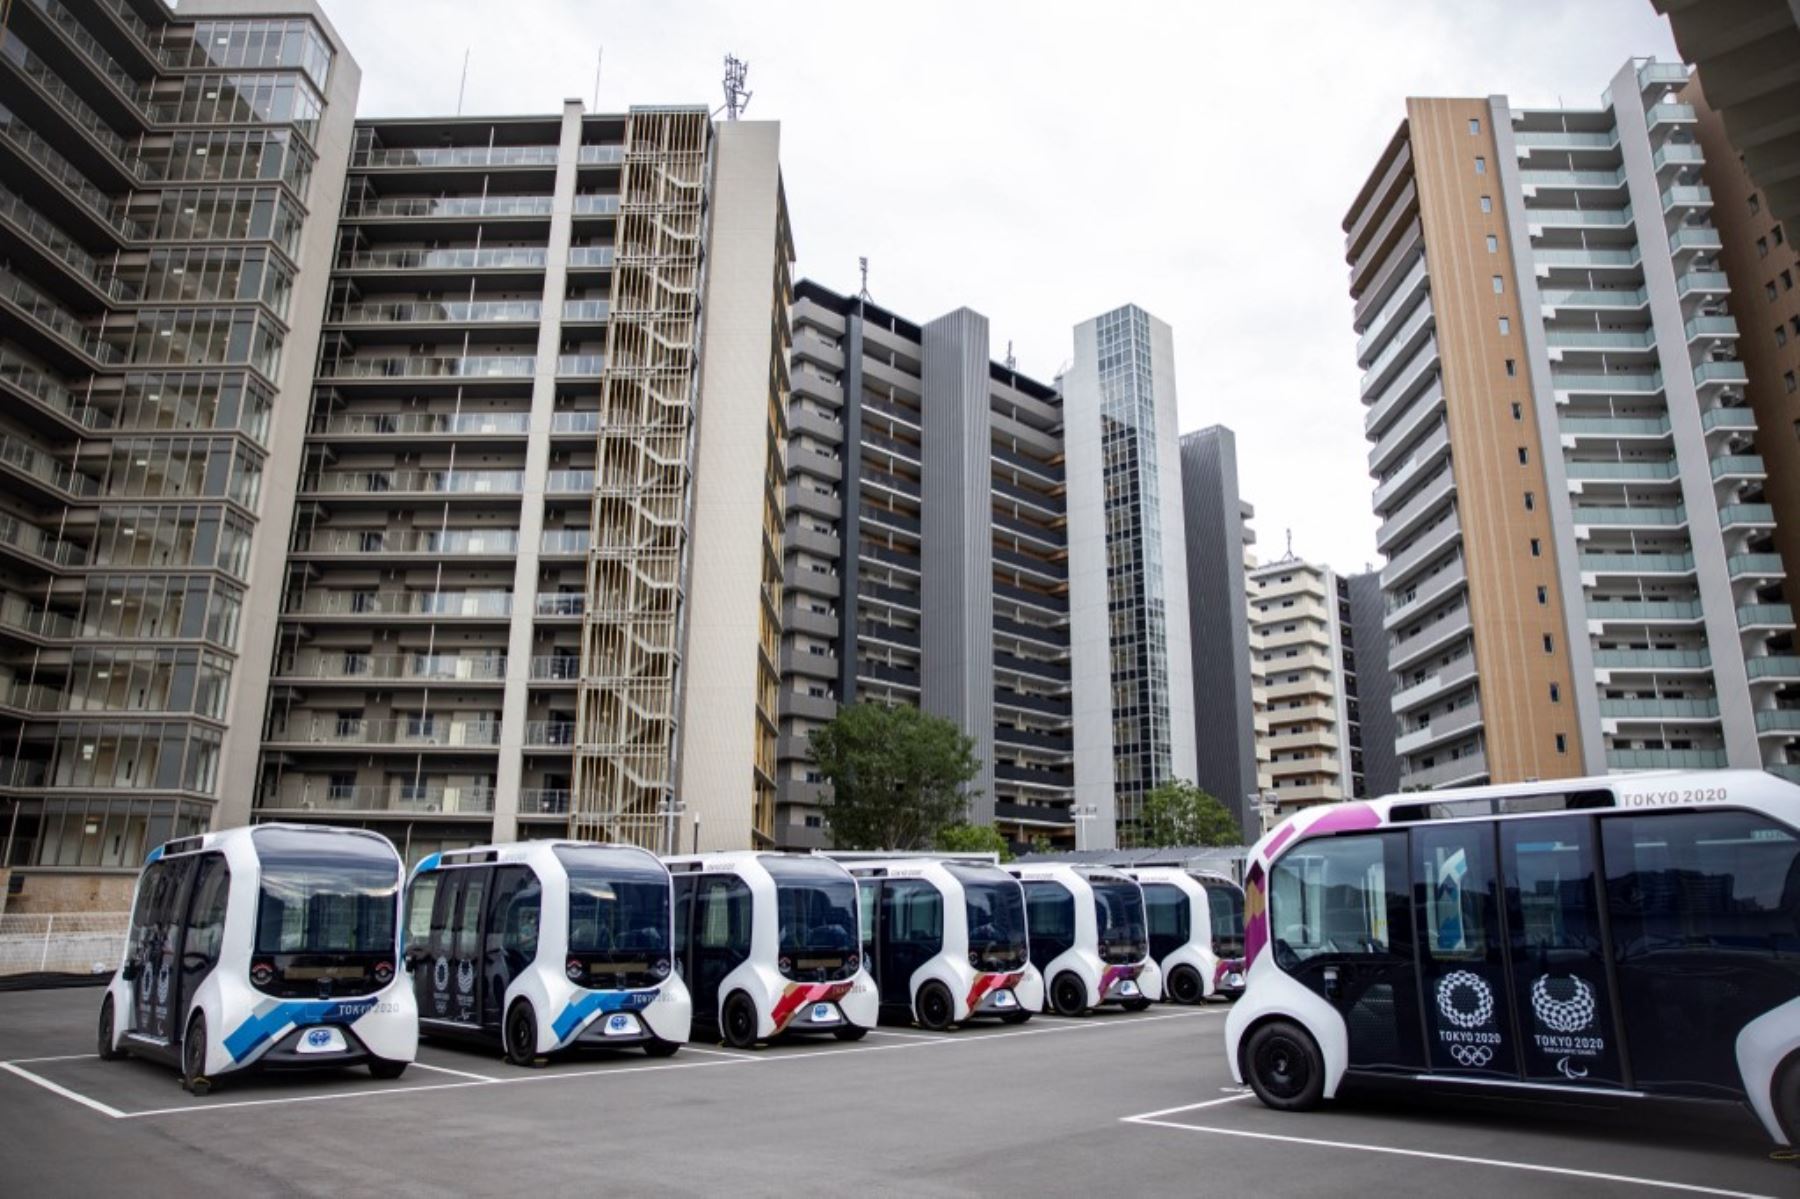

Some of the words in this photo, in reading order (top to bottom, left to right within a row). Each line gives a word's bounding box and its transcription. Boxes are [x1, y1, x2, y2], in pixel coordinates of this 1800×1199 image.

[1623, 790, 1679, 807] TOKYO
[1683, 787, 1728, 803] 2020
[1439, 1029, 1474, 1042] TOKYO
[1475, 1032, 1502, 1044] 2020
[1534, 1034, 1573, 1048] TOKYO
[1574, 1036, 1604, 1050] 2020
